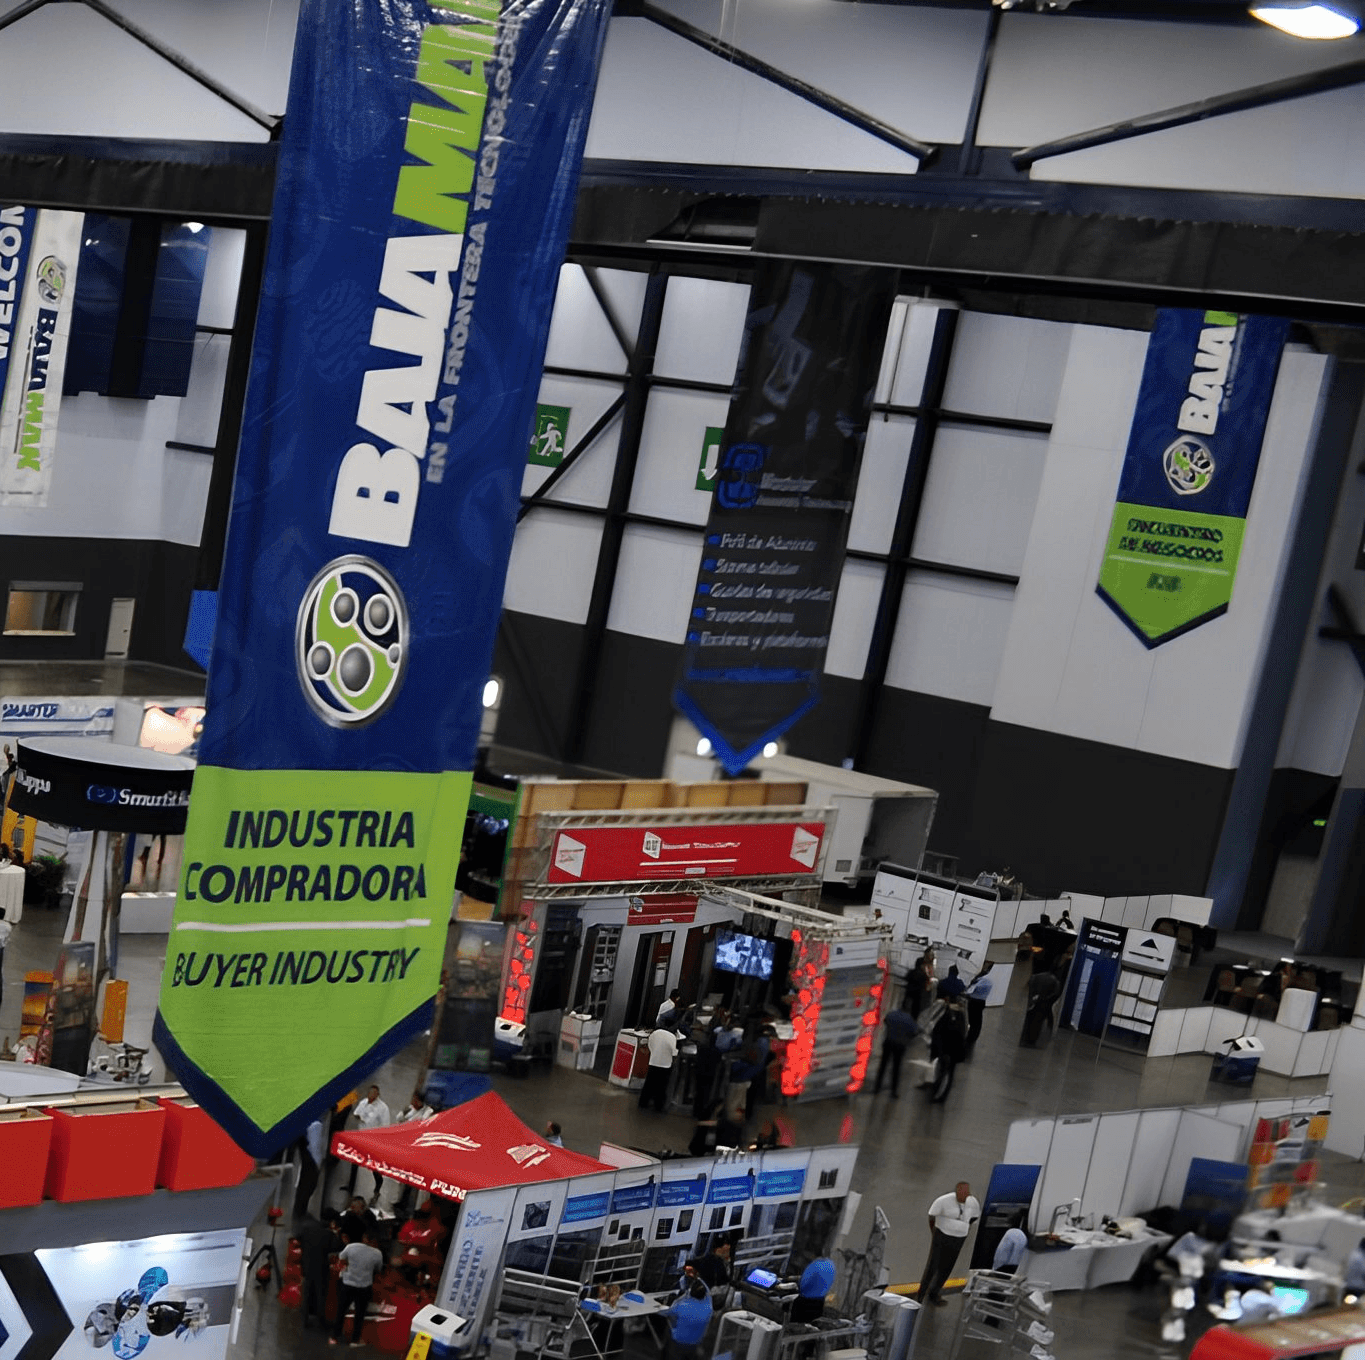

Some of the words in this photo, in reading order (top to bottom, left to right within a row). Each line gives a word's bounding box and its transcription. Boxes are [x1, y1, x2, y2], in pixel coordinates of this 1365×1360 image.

[326, 0, 501, 547] BAJAMA
[223, 809, 416, 849] INDUSTRIA
[184, 862, 427, 903] COMPRADORA
[172, 952, 267, 988] BUYER
[268, 947, 420, 986] INDUSTRY
